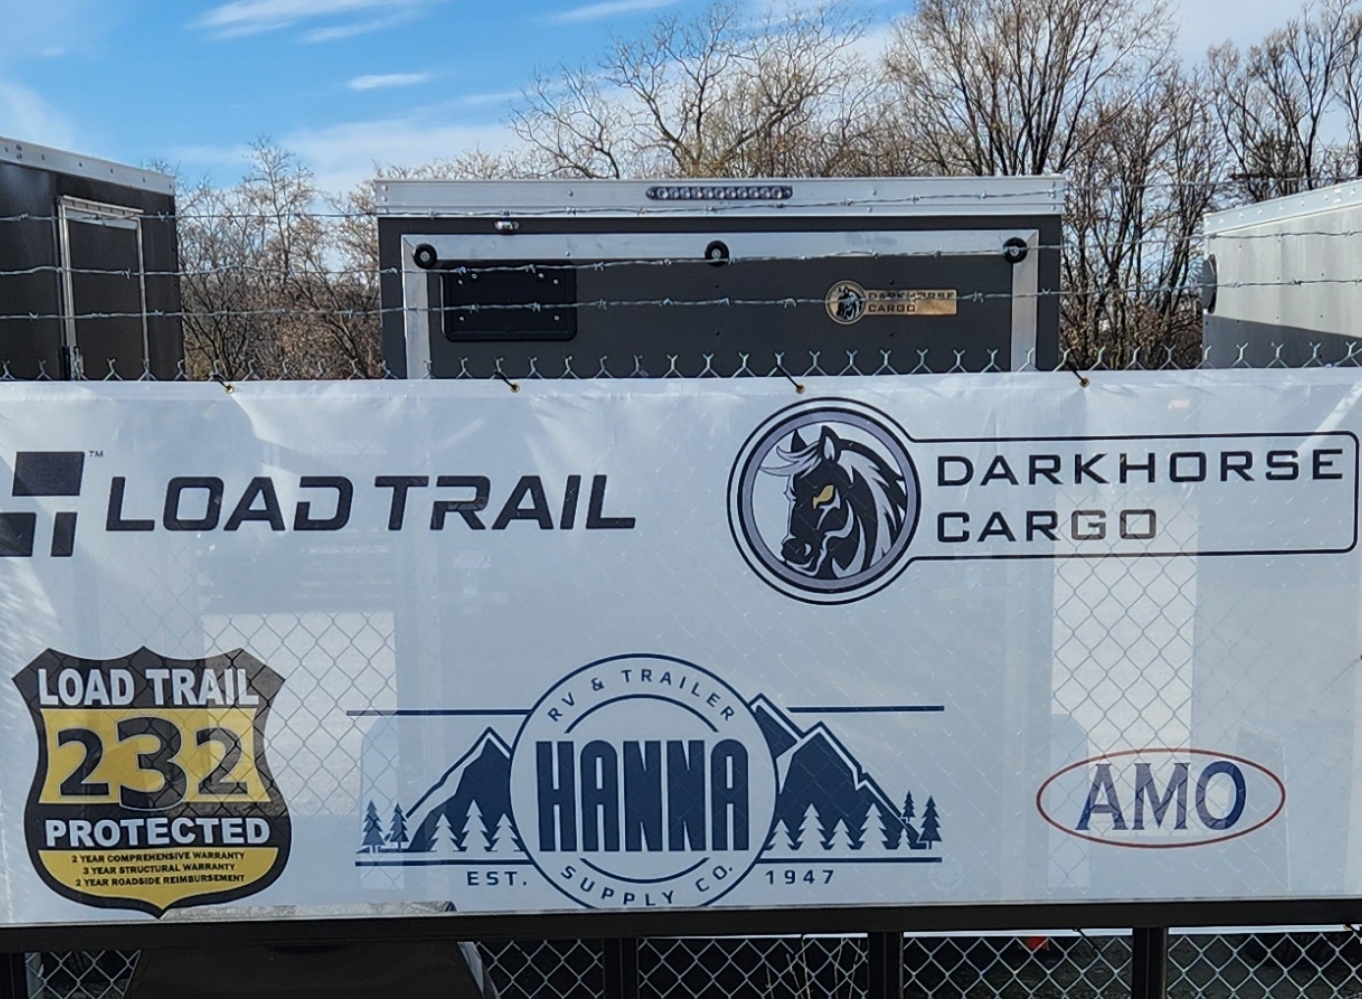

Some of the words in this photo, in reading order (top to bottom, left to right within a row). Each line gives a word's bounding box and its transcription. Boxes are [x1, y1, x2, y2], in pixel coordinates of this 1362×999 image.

[868, 304, 916, 313] CARGO
[936, 449, 1344, 487] DARKHORSE
[105, 475, 354, 531] LOAD
[374, 474, 636, 531] TRAIL
[936, 508, 1157, 543] CARGO
[39, 669, 134, 706] LOAD
[145, 668, 259, 706] TRAIL
[547, 692, 575, 722] RV
[590, 677, 605, 692] &
[621, 668, 736, 721] TRAILER
[56, 716, 249, 812] 232
[536, 739, 749, 852] HANNA
[1074, 760, 1247, 831] AMO
[45, 817, 270, 848] PROTECTED
[71, 855, 78, 863] 2
[80, 855, 105, 863] YEAR
[107, 852, 191, 863] COMPREHENSIVE
[193, 851, 245, 861] WARRANTY
[83, 867, 89, 875] 3
[91, 867, 116, 875] YEAR
[119, 865, 180, 874] STRUCTURAL
[183, 863, 235, 871] WARRANTY
[75, 879, 82, 887] 2
[84, 879, 109, 887] YEAR
[111, 877, 161, 886] ROADSIDE
[163, 874, 245, 885] REIMBURSEMENT
[467, 871, 528, 887] EST.
[560, 865, 675, 907] SUPPLY
[695, 864, 734, 893] CO.
[765, 869, 836, 886] 1947
